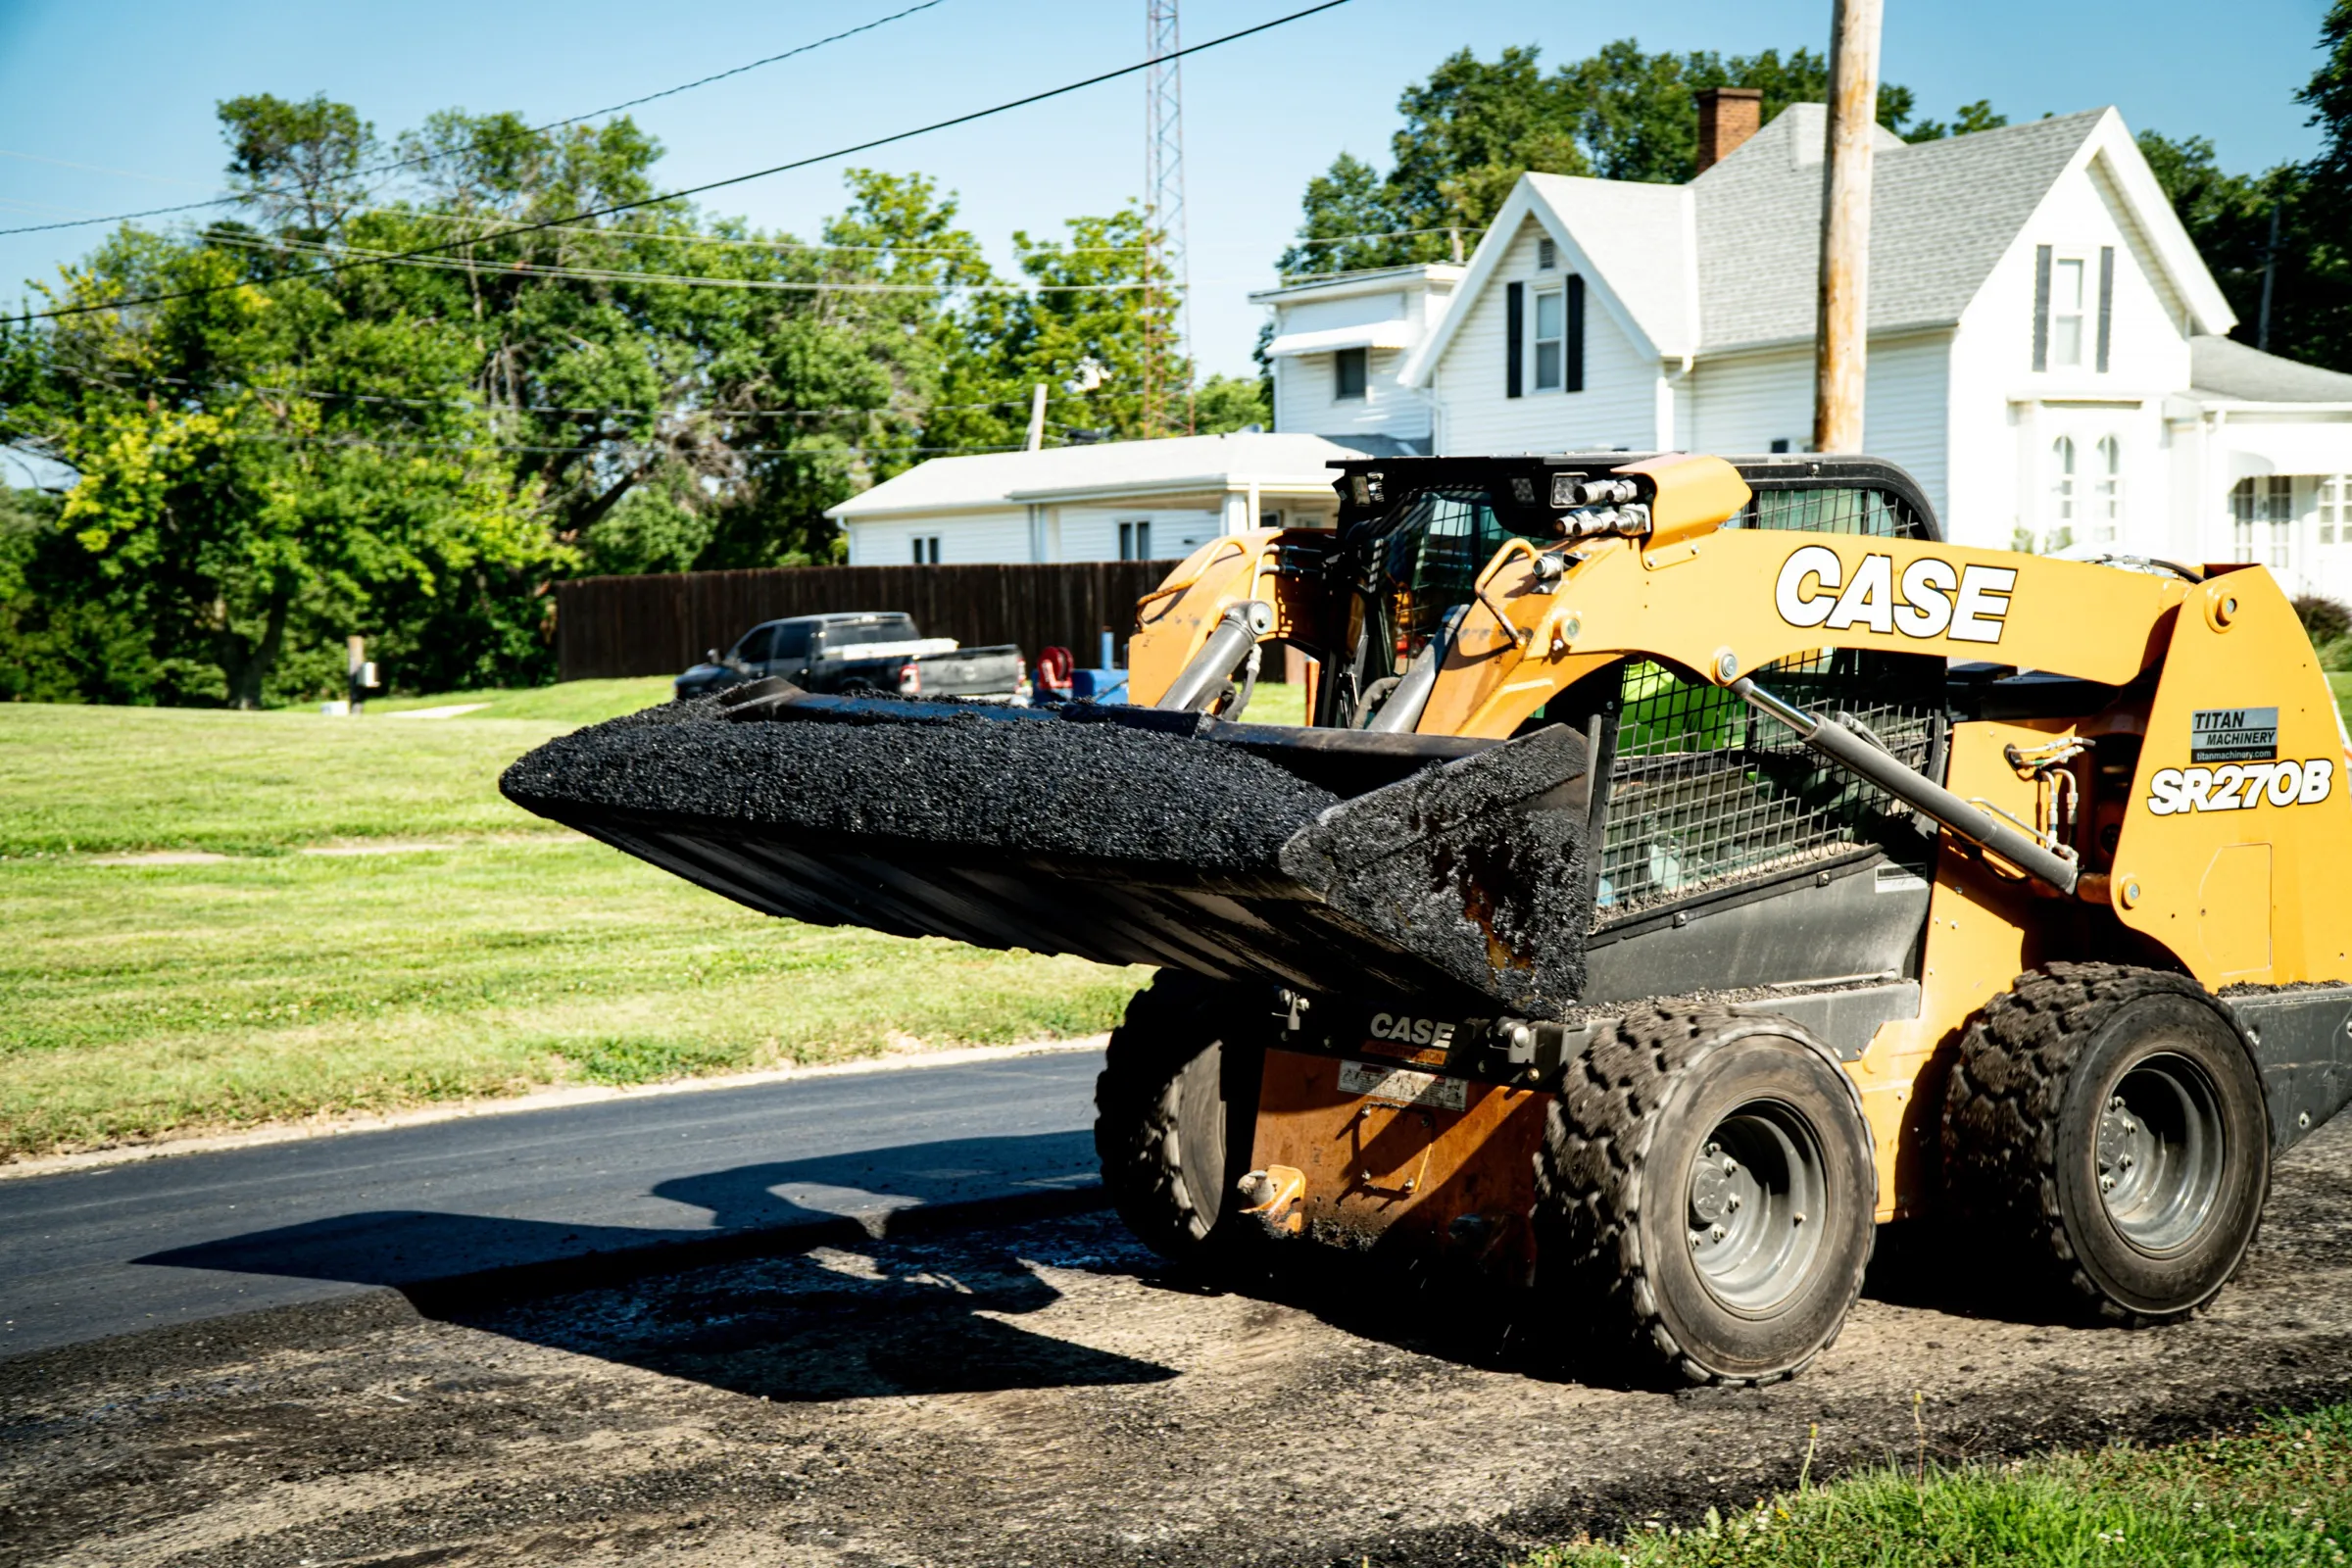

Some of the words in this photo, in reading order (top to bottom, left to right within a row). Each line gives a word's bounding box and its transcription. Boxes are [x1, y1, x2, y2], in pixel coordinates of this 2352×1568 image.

[1775, 545, 2019, 644] CASE
[2195, 711, 2245, 729] TITAN
[2206, 731, 2276, 746] MACHINERY
[2196, 750, 2272, 760] titanmachinery.com
[2147, 759, 2333, 816] SR270B
[1370, 1012, 1455, 1049] CASE
